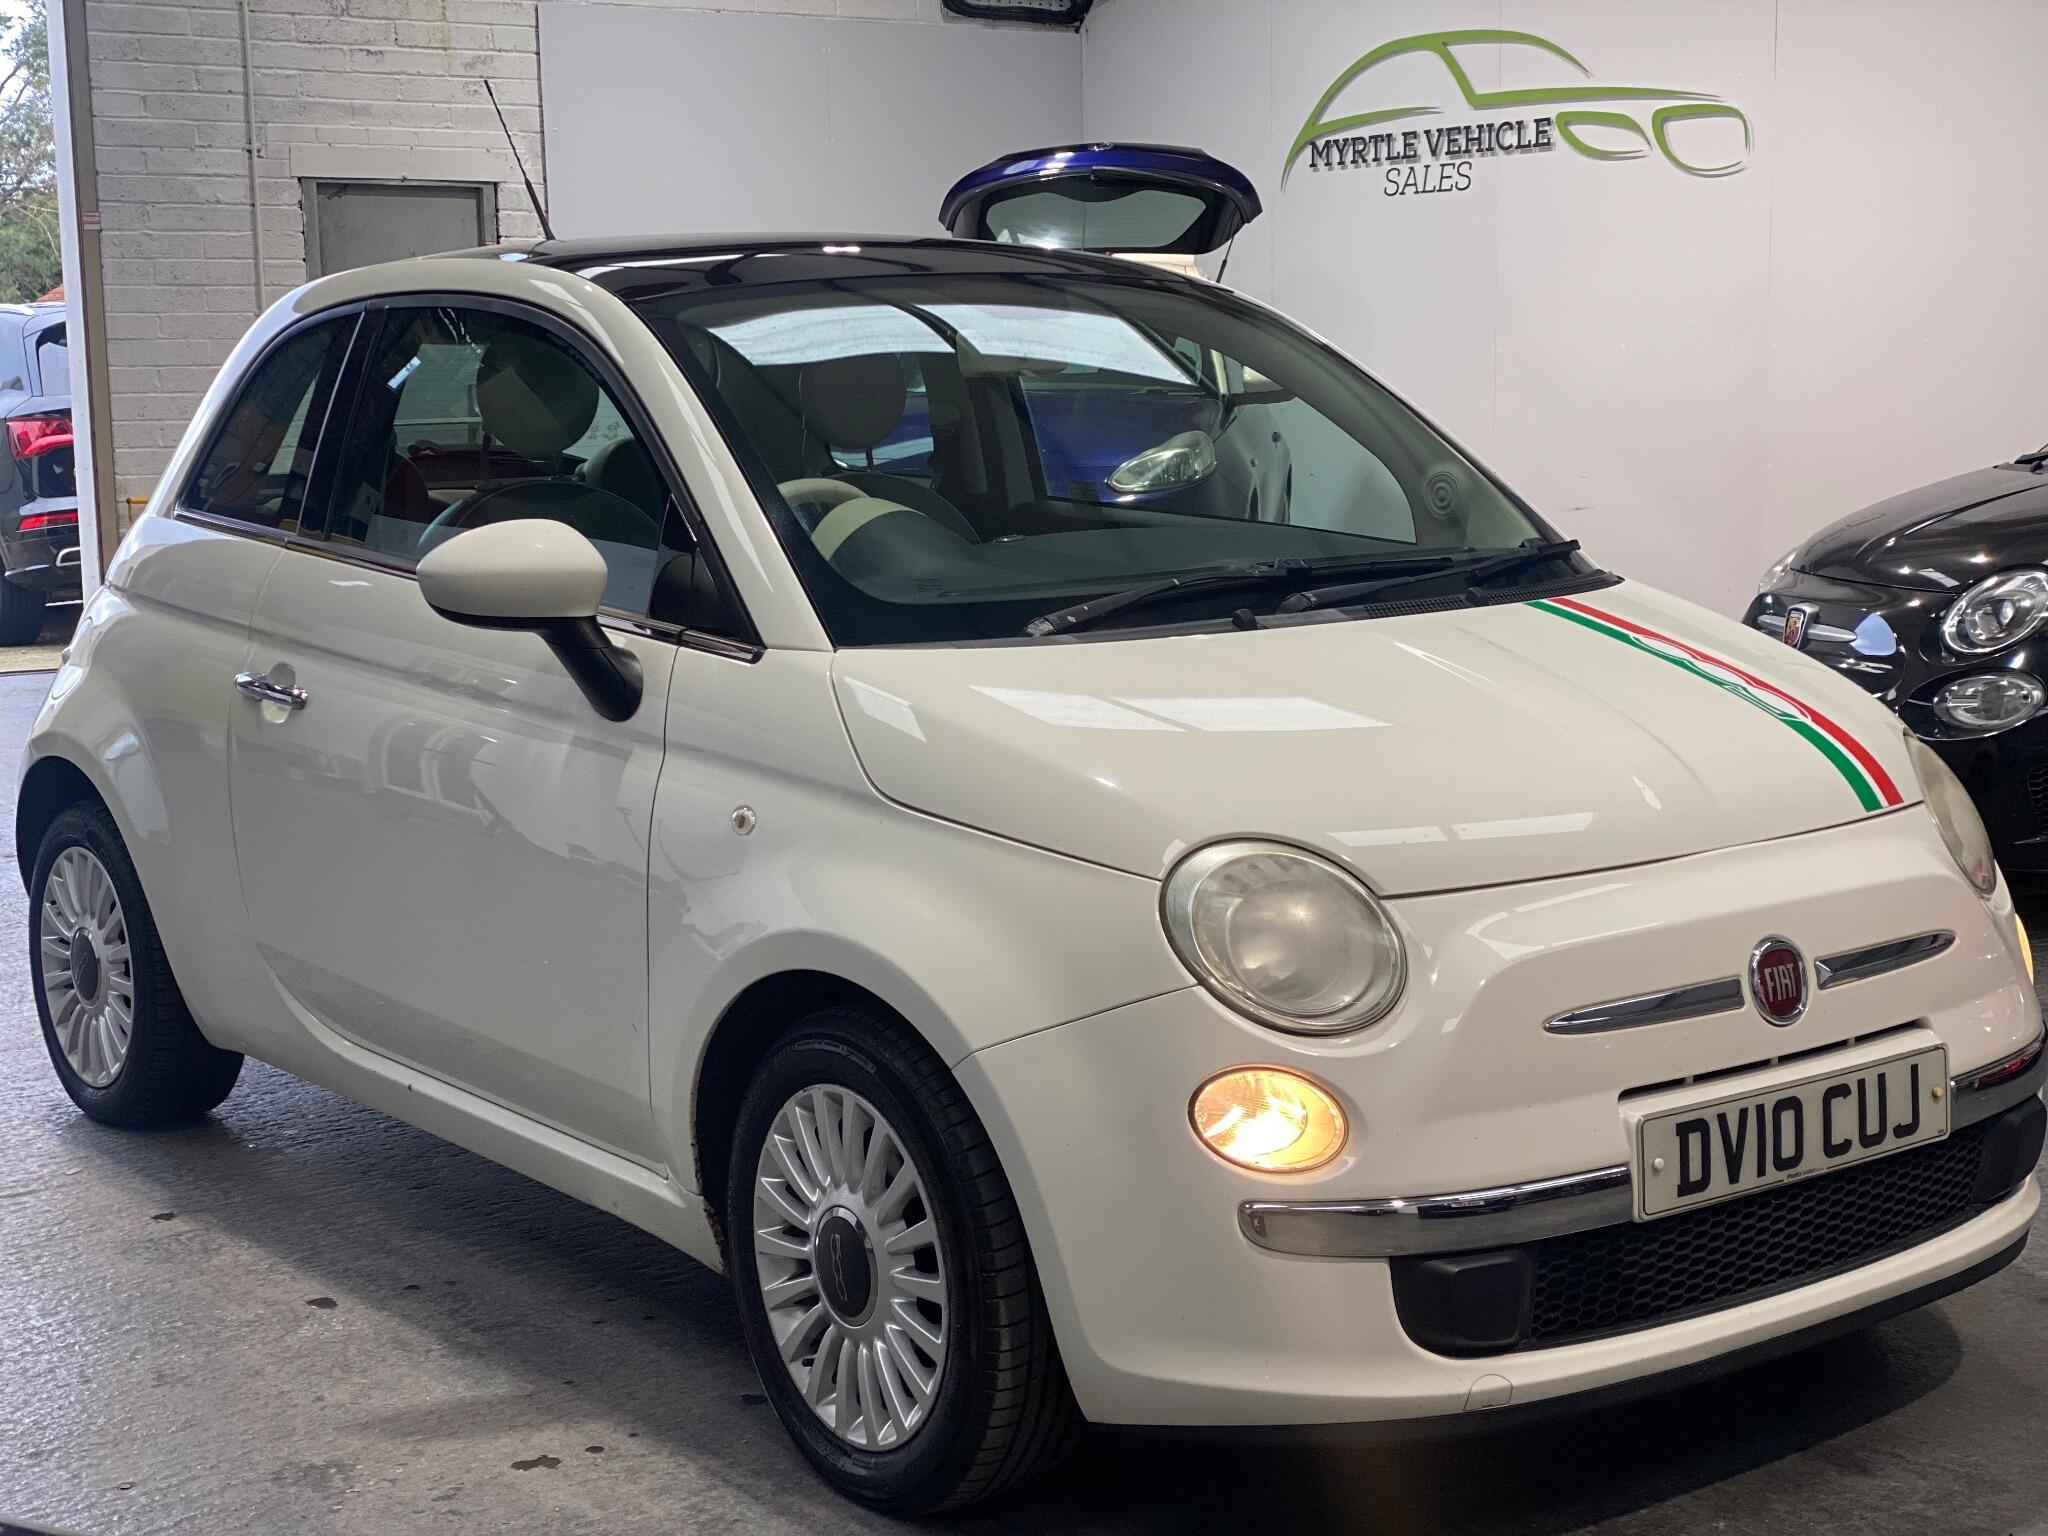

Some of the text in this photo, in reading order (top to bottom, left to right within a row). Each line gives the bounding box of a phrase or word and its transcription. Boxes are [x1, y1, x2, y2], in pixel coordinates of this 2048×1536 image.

[1309, 117, 1552, 168] MYRTLE VEHICLE
[1383, 161, 1473, 197] SALES
[1763, 962, 1797, 1003] FIAT
[1675, 1063, 1920, 1198] DV10 CUJ
